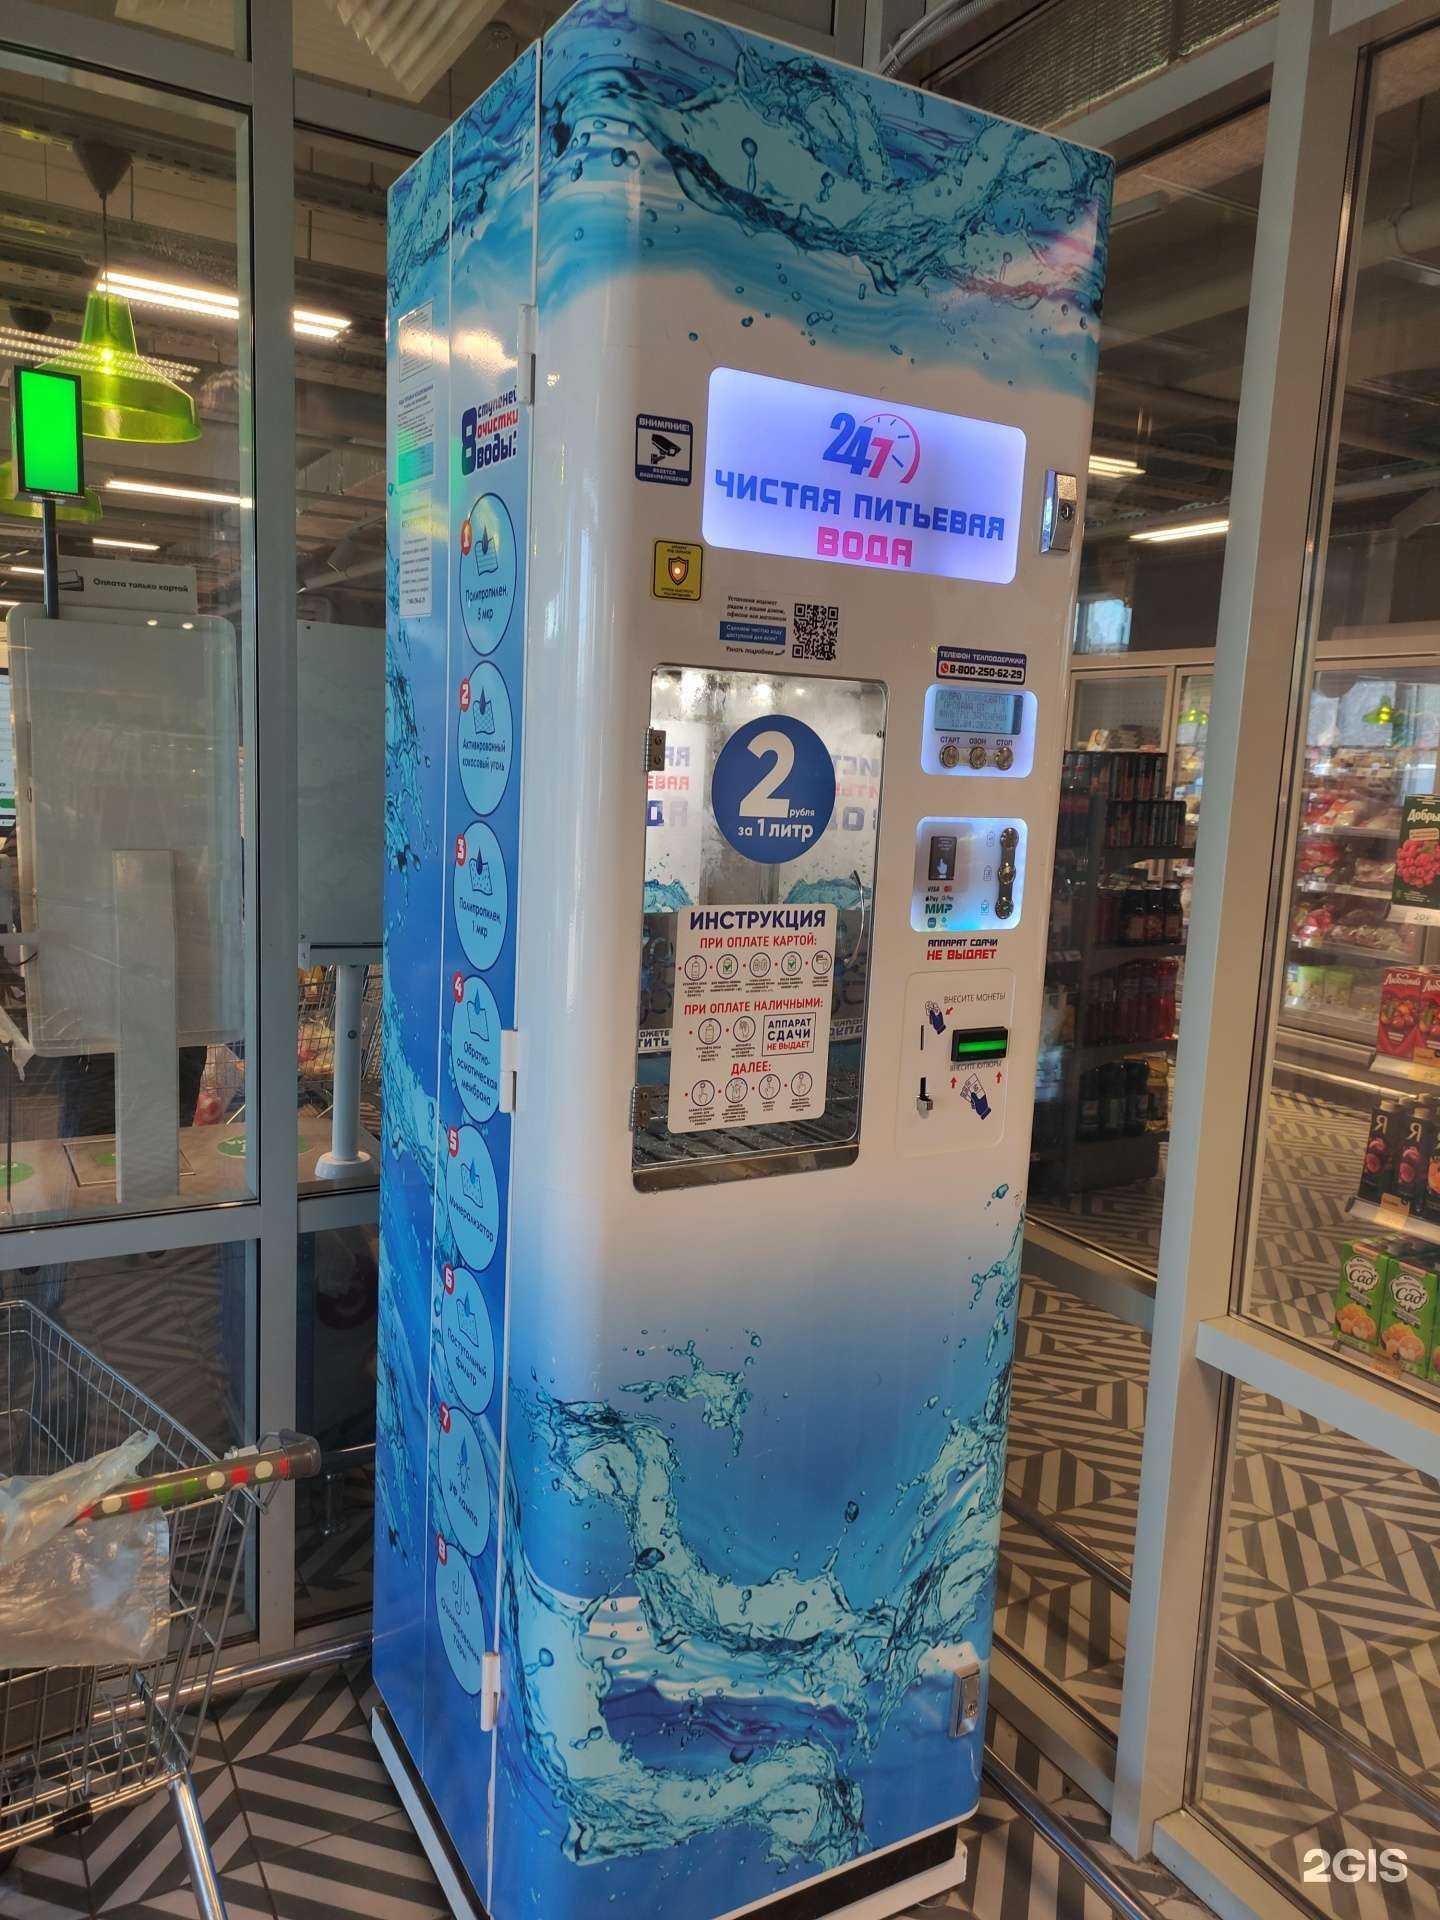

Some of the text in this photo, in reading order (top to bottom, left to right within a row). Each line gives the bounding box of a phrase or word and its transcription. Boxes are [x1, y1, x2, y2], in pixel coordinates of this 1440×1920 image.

[477, 408, 519, 439] очистки
[461, 407, 477, 476] 8
[477, 430, 517, 470] воды:
[715, 468, 1005, 541] ЧИСТАЯ ПИТЬЕВАЯ
[816, 526, 914, 569] ВОДА
[93, 578, 189, 593] Оплата только картой
[940, 650, 971, 660] ТЕЛЕФОН
[950, 664, 1023, 679] 8-800-250-62-29
[461, 683, 470, 705] 2
[940, 736, 960, 744] СТАРТ
[996, 738, 1013, 746] СТОП
[739, 730, 795, 819] 2
[789, 807, 815, 819] рубля
[1407, 808, 1440, 824] Добры
[737, 818, 814, 843] за 1 литр
[457, 838, 465, 860] 3
[925, 903, 953, 914] МИР
[690, 909, 826, 932] ИНСТРУКЦИЯ
[700, 932, 817, 949] ПРИ ОПЛАТЕ КАРТОЙ:
[927, 938, 998, 947] АППАРАТ СДАЧИ
[926, 948, 998, 960] НЕ ВЫДАЕТ
[455, 976, 462, 996] 4
[943, 991, 1006, 1004] ВНЕСИТЕ МОНЕТЫ
[684, 997, 824, 1015] ПРИ ОПЛАТЕ НАЛИЧНЫМИ:
[768, 1018, 812, 1029] АППАРАТ
[640, 1030, 669, 1038] ОЖЕТЕ
[767, 1028, 811, 1042] СДАЧИ
[767, 1040, 810, 1051] НЕ ВЫДАЕТ
[730, 1061, 772, 1076] ДАЛЕЕ:
